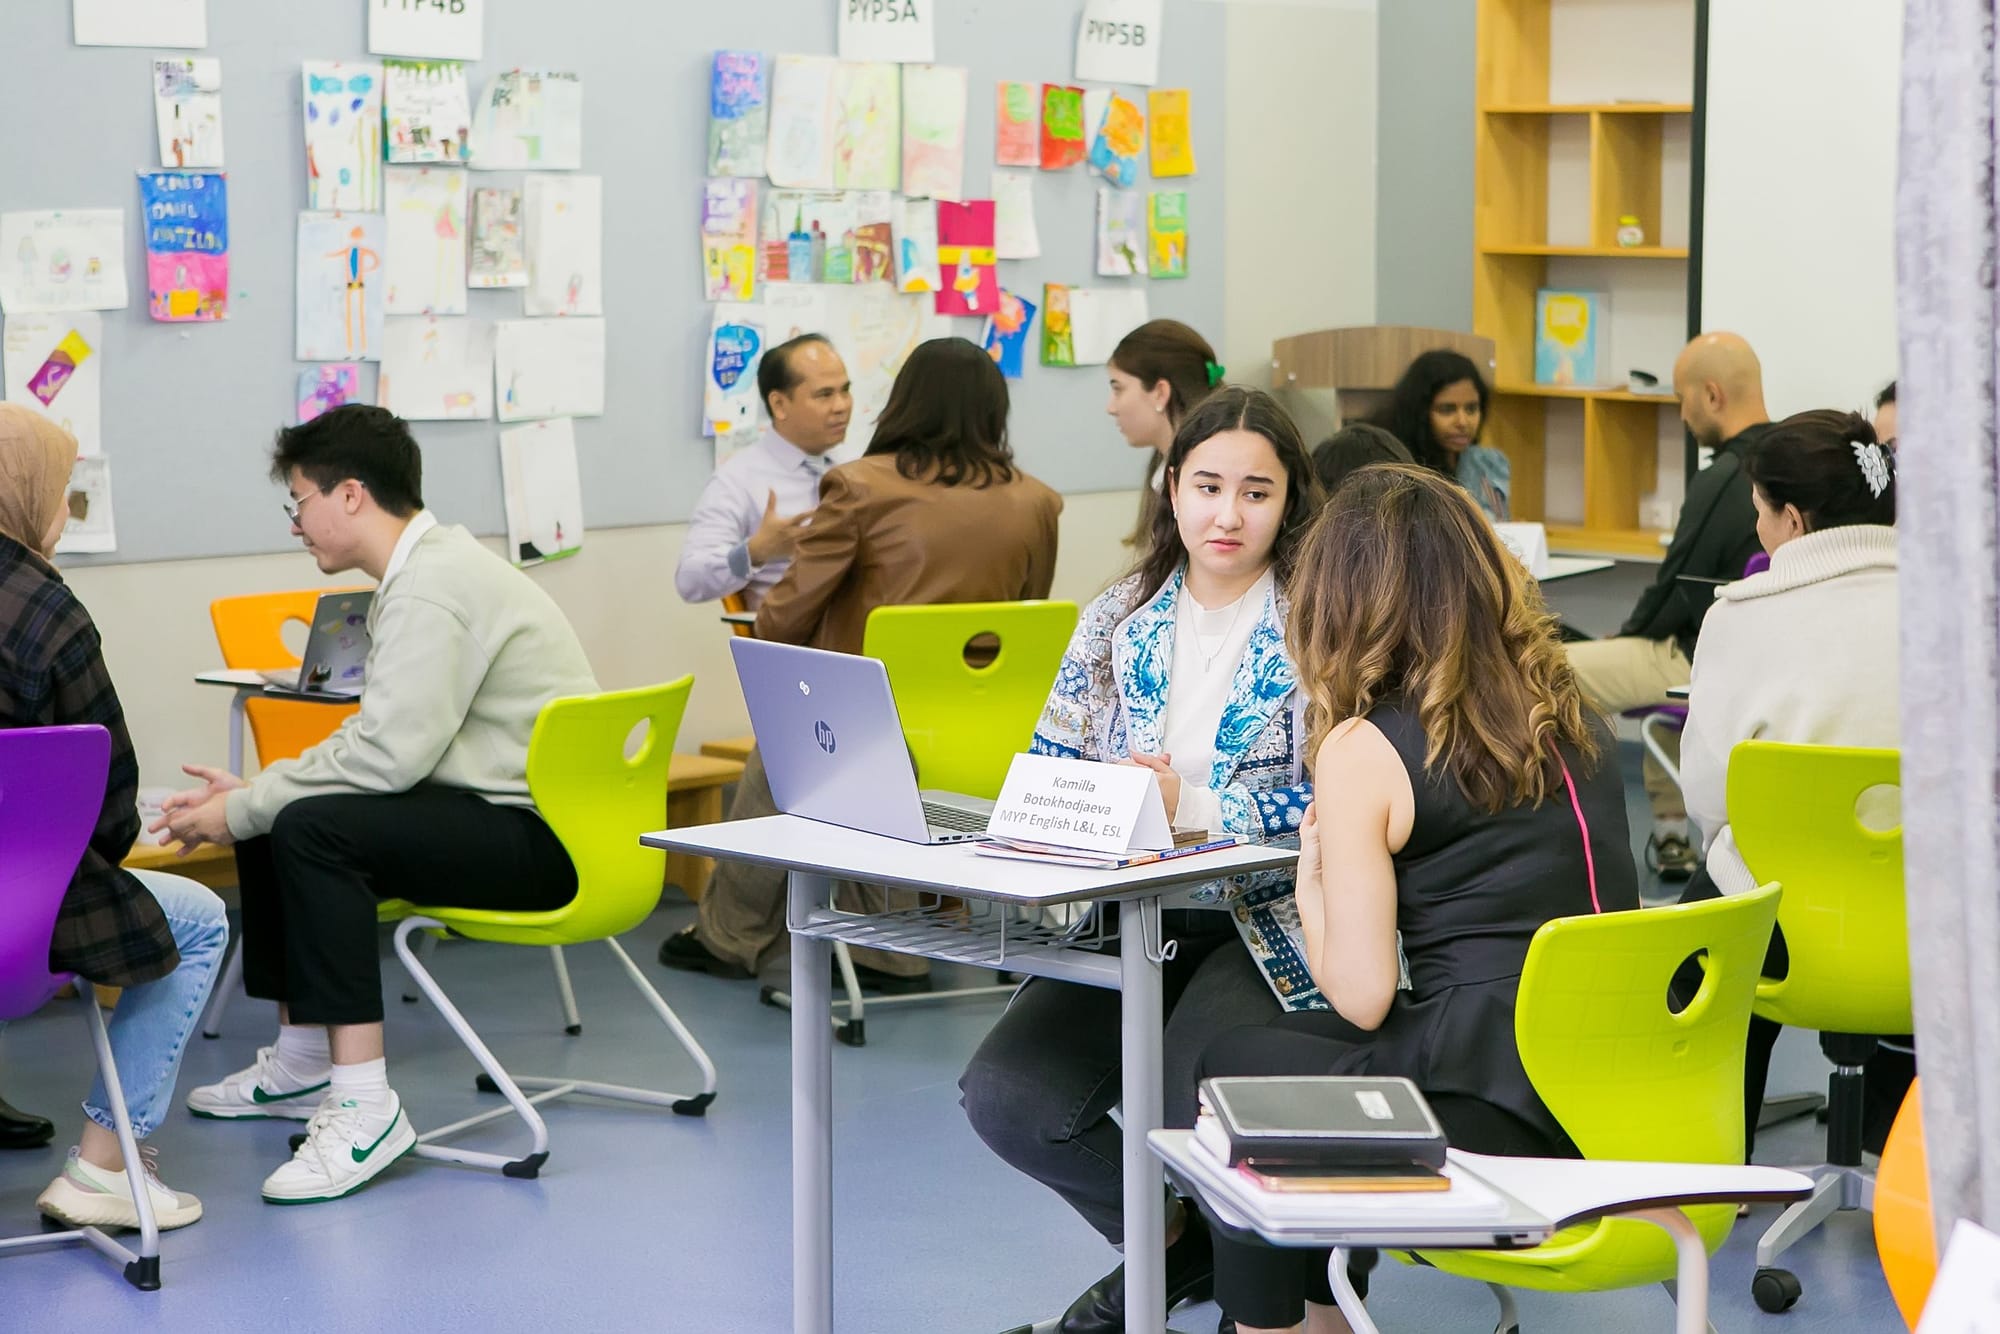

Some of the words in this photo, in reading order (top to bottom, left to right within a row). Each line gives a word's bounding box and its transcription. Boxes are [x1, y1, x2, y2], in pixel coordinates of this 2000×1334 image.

[848, 0, 920, 22] PYP5A
[1087, 19, 1146, 47] PYP5B
[1052, 776, 1096, 793] Kamilla
[1023, 792, 1112, 816] Botokhodjaeva
[1000, 809, 1028, 824] MYP
[1029, 814, 1070, 831] English
[1073, 820, 1098, 836] L&L,
[1102, 824, 1121, 838] ESL
